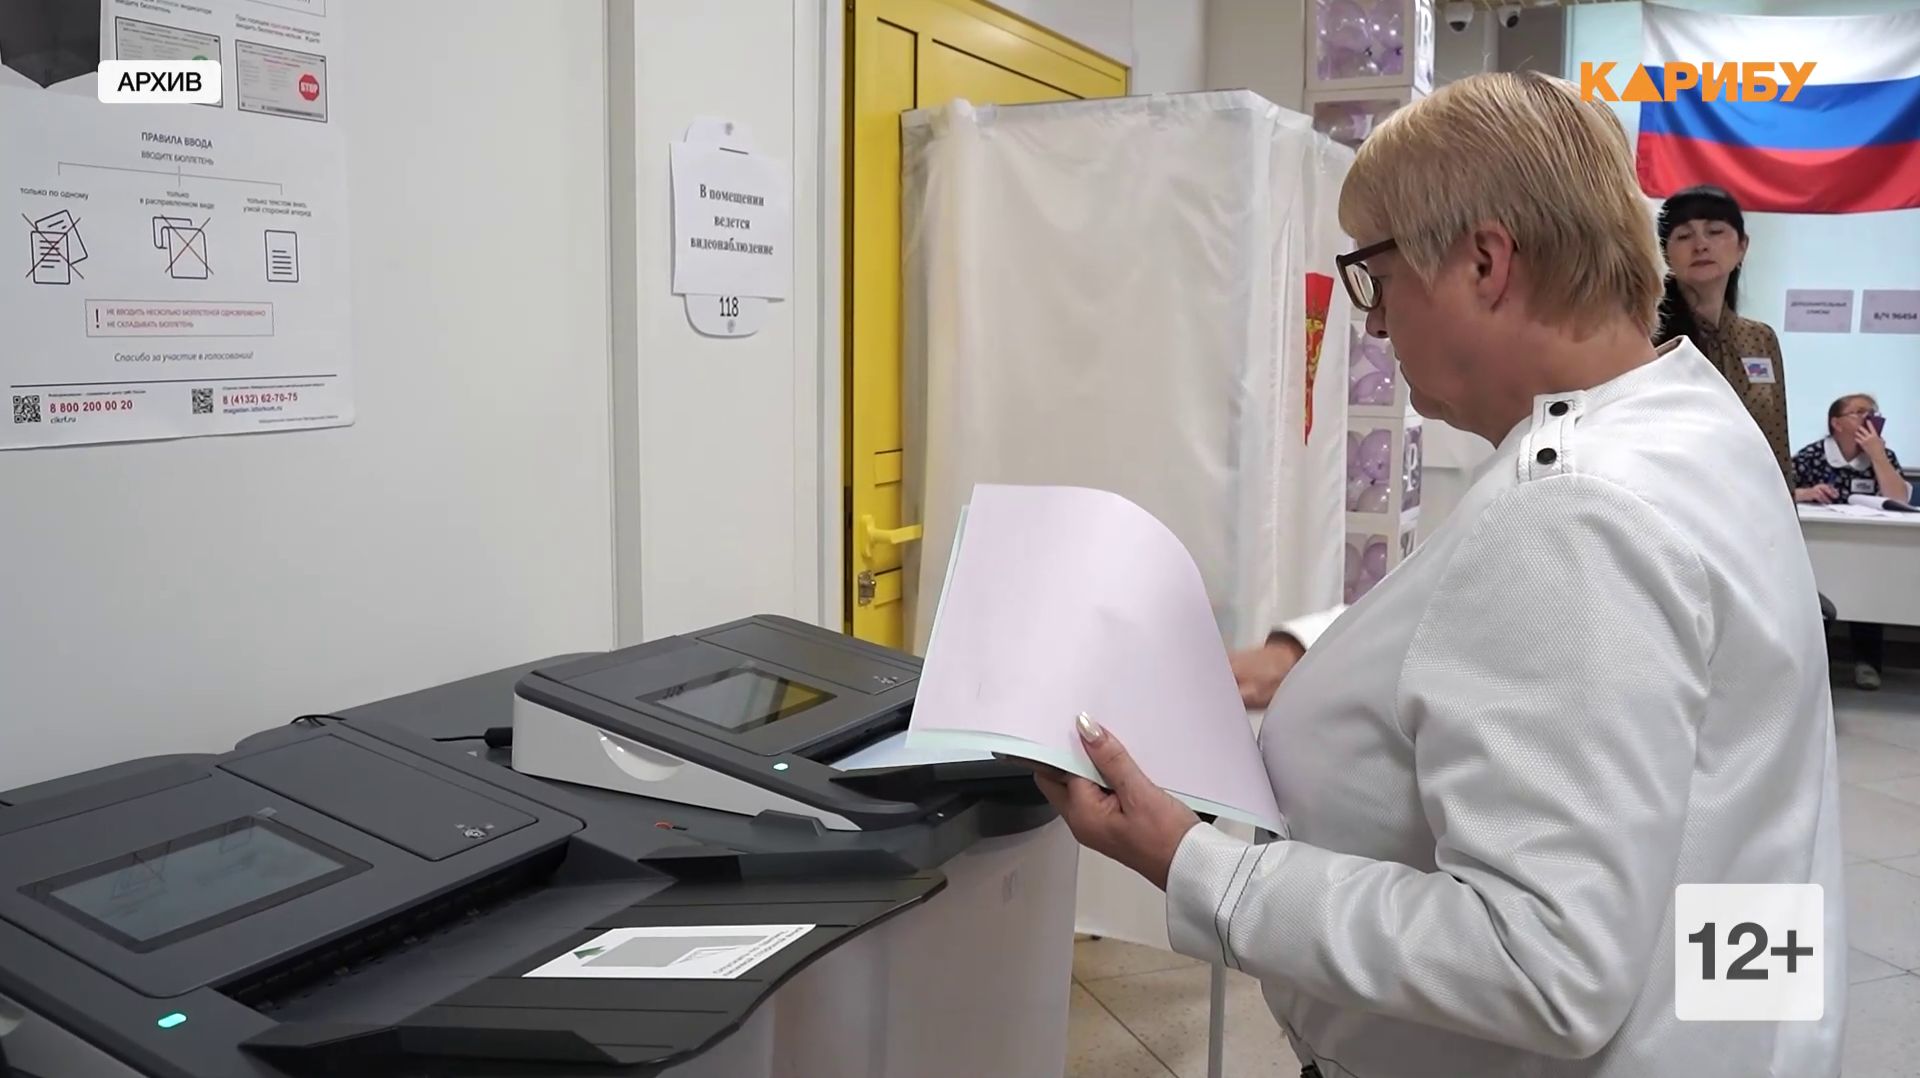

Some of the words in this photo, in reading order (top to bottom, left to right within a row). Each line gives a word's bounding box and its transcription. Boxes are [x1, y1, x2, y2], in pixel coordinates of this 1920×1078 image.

[299, 82, 320, 94] STOP
[141, 131, 183, 145] ПРАВИЛА
[184, 137, 213, 149] ВВОДА
[20, 187, 47, 196] только
[60, 191, 89, 201] одному
[700, 184, 707, 199] В
[709, 188, 764, 206] помещении
[714, 215, 751, 230] ведется
[690, 237, 774, 256] видеонаблюдение
[719, 296, 739, 317] 118
[114, 352, 151, 363] Спасибо
[151, 354, 162, 362] за
[162, 353, 196, 365] участие
[230, 393, 259, 406] (4132)
[260, 392, 298, 403] 62-70-75
[49, 402, 57, 413] 8
[60, 402, 79, 413] 800
[83, 401, 102, 412] 200
[104, 400, 117, 411] 00
[120, 400, 133, 410] 20
[50, 416, 77, 424] cikrf.ru
